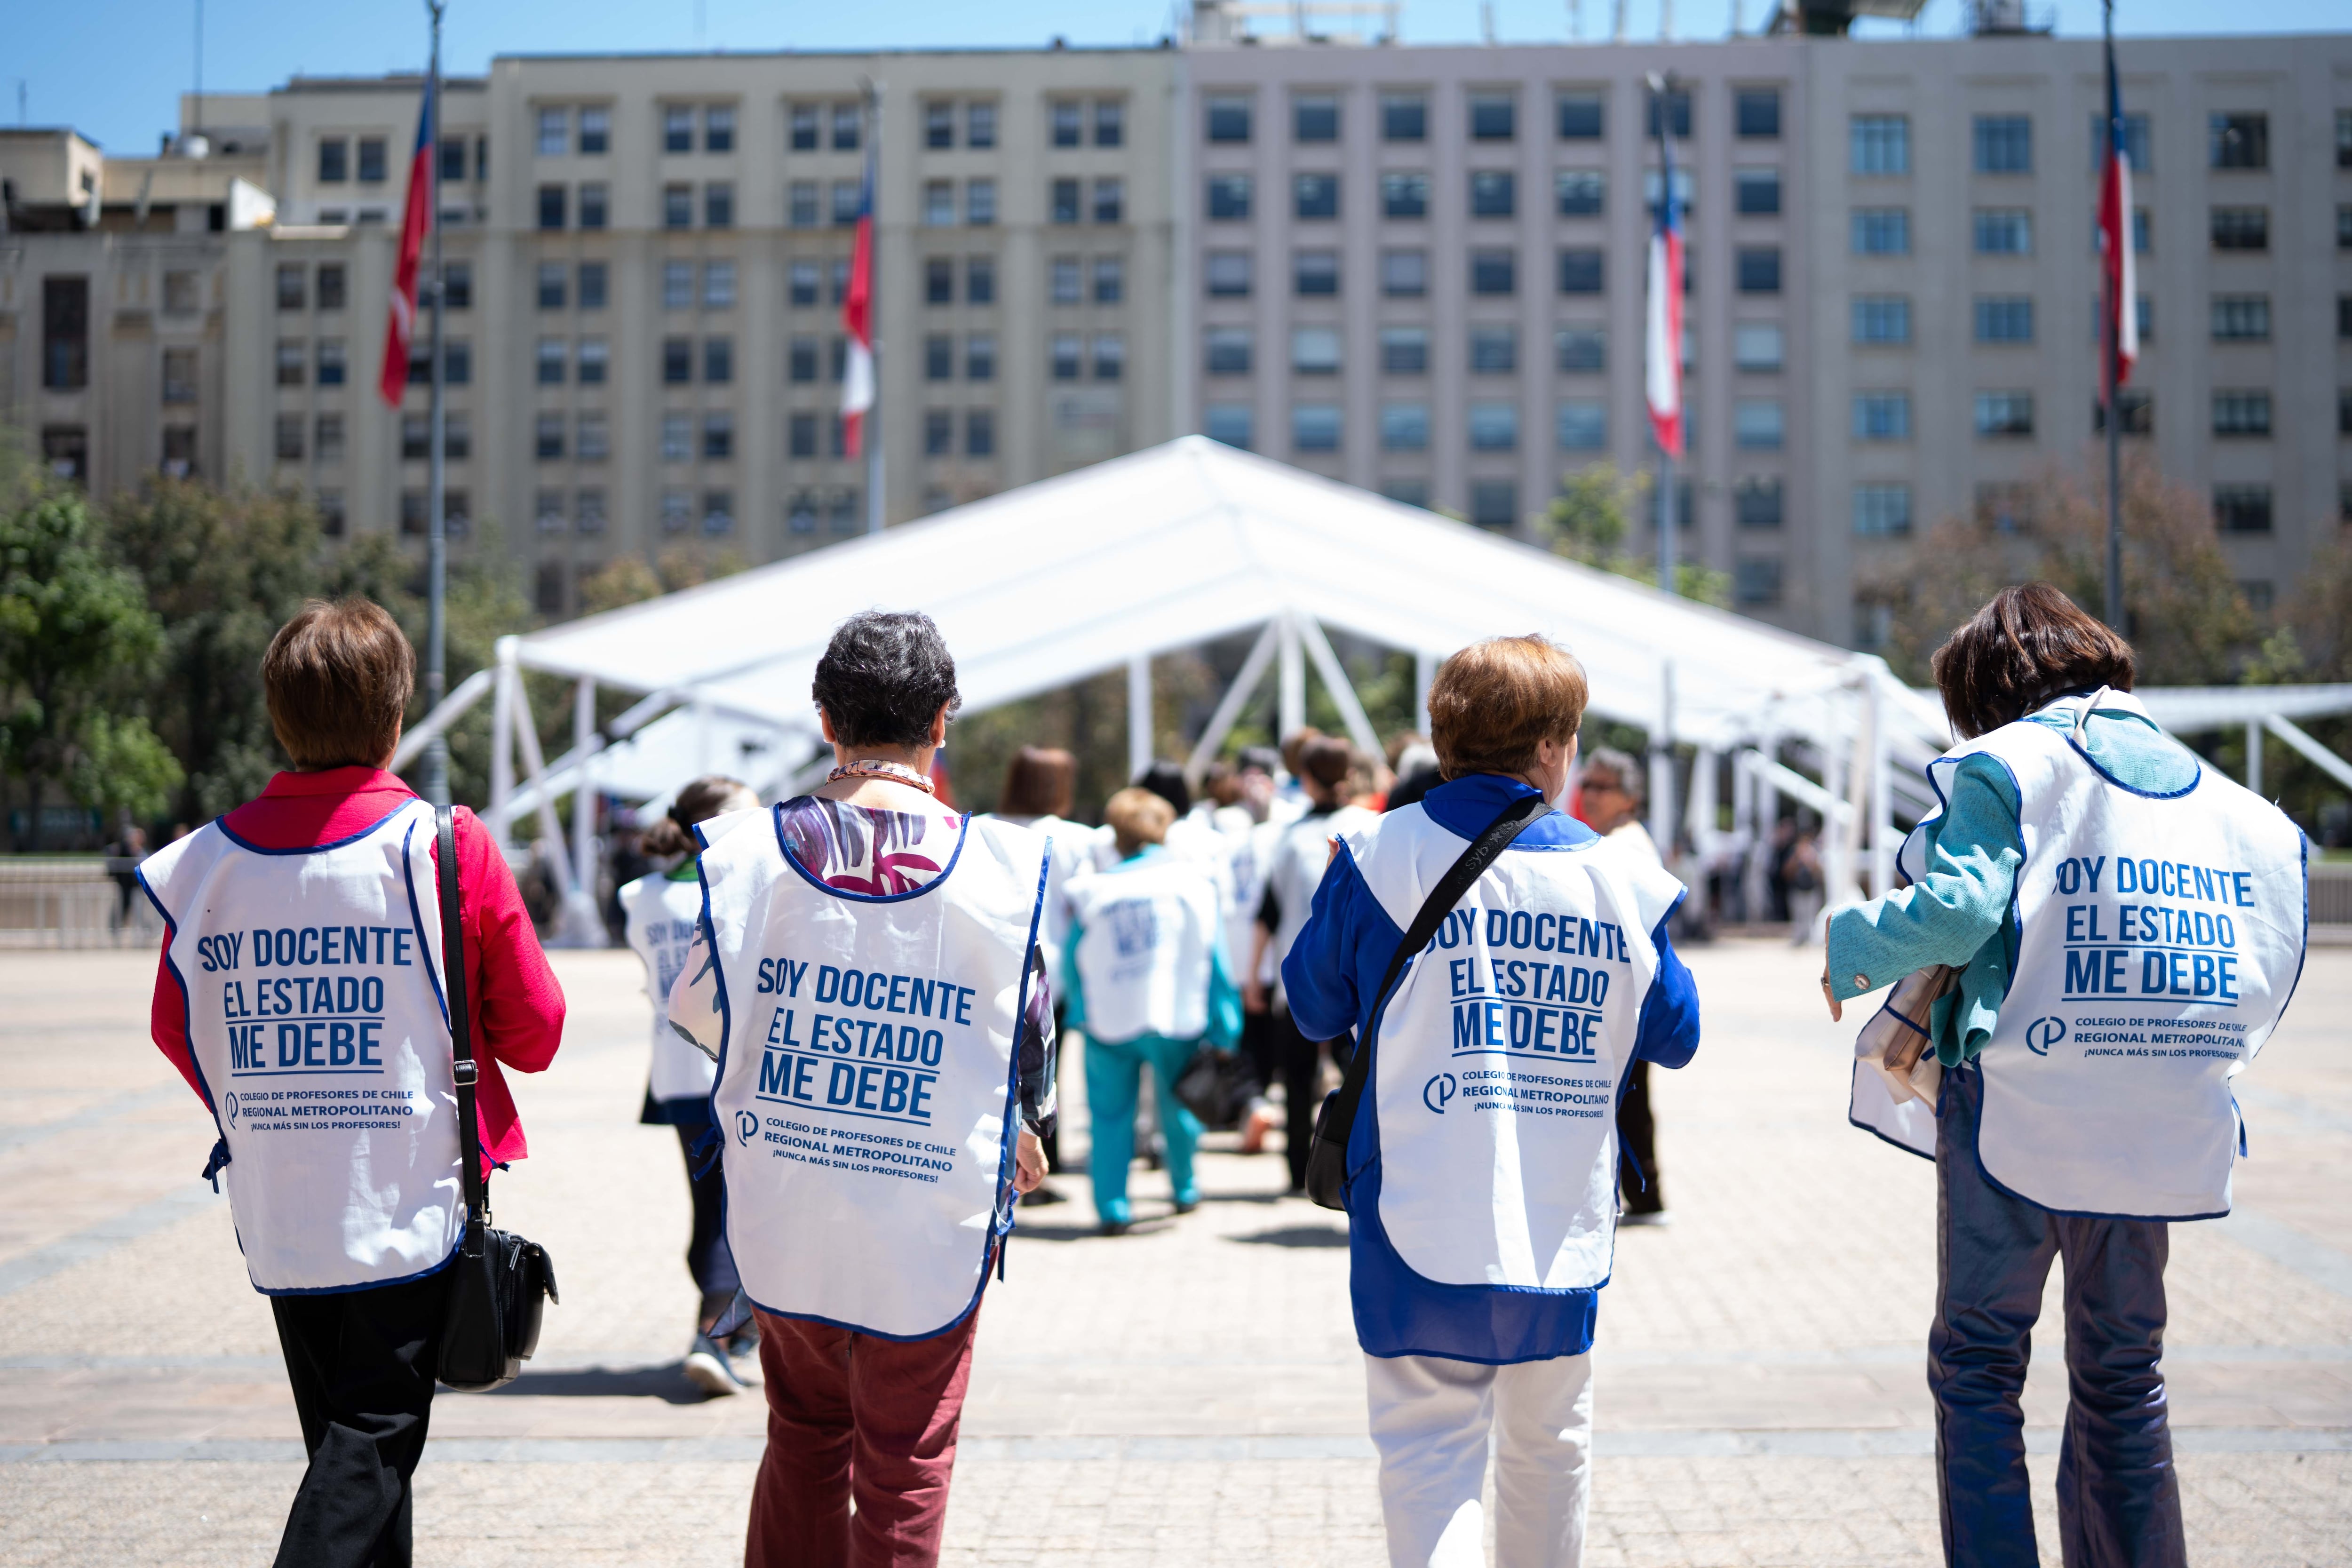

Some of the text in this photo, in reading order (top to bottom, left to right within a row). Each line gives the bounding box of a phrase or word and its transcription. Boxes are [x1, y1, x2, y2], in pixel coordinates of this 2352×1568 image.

[2117, 856, 2255, 907] DOCENTE
[2066, 905, 2235, 948] EL ESTADO
[198, 926, 413, 971] SOY DOCENTE
[757, 958, 976, 1026] SOY DOCENTE
[1449, 957, 1610, 1007] EL ESTADO
[2064, 950, 2238, 1000] ME DEBE
[224, 976, 383, 1018] EL ESTADO
[228, 1022, 382, 1069] ME DEBE
[767, 1007, 944, 1067] EL ESTADO
[1453, 1002, 1602, 1055] ME DEBE
[2074, 1033, 2147, 1043] REGIONAL
[2147, 1019, 2217, 1028] PROFESORES
[2218, 1022, 2230, 1031] DE
[2084, 1049, 2123, 1058] ¡NUNCA
[2127, 1047, 2148, 1056] MÁS
[2189, 1050, 2239, 1059] PROFESORES!
[240, 1092, 269, 1101] COLEGIO
[287, 1090, 358, 1099] PROFESORES
[381, 1090, 413, 1099] CHILE
[758, 1050, 937, 1119] ME DEBE
[1462, 1071, 1504, 1080] COLEGIO
[1518, 1073, 1583, 1087] PROFESORES
[1463, 1086, 1609, 1104] REGIONAL METROPOLITANO
[242, 1106, 413, 1117] REGIONAL METROPOLITANO
[251, 1122, 270, 1132] ¡NUNCA
[273, 1121, 291, 1130] MÁS
[1507, 1103, 1519, 1111] MÁS
[1556, 1108, 1604, 1118] PROFESORES!
[764, 1131, 953, 1172] REGIONAL METROPOLITANO
[766, 1117, 956, 1156] COLEGIO DE PROFESORES DE CHILE
[773, 1149, 938, 1183] ¡NUNCA MÁS SIN LOS PROFESORES!
